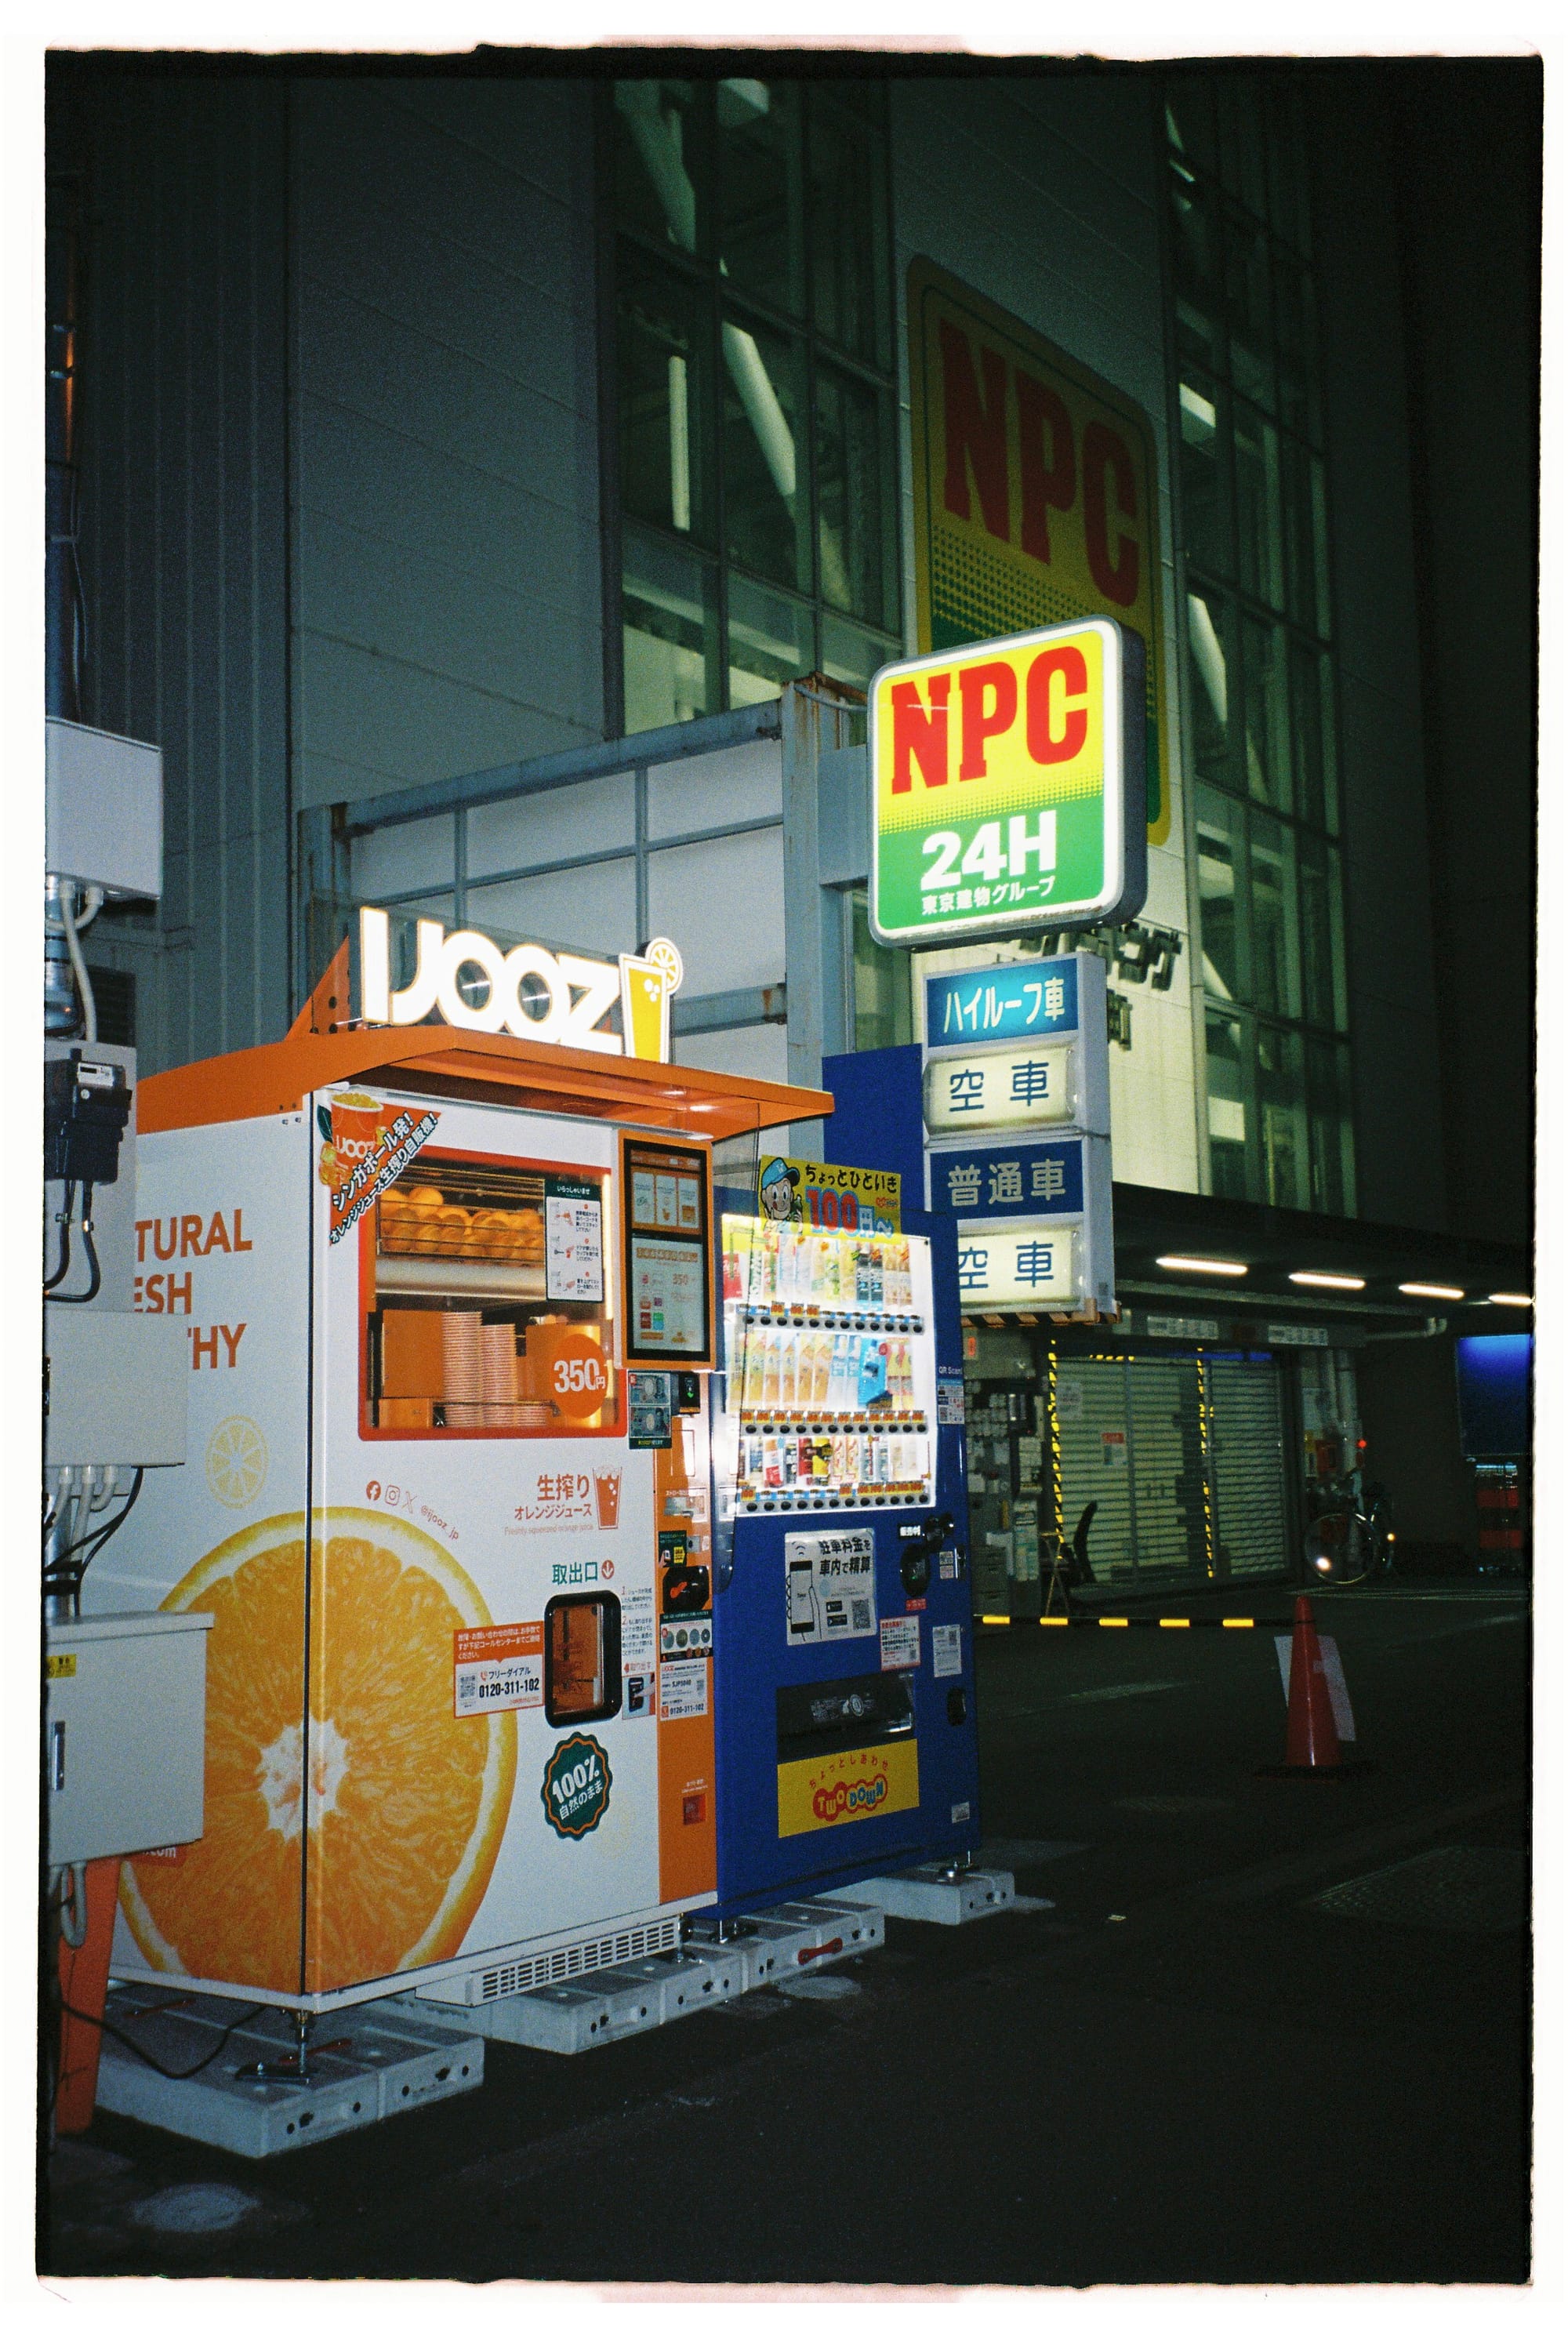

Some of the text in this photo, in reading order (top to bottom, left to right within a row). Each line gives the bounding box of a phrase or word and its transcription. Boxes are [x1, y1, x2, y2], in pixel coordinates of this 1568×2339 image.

[941, 314, 1140, 608] NPC
[891, 645, 1087, 795] NPC
[920, 809, 1057, 892] 24H
[921, 876, 1056, 915] 東京建物グループ
[944, 976, 1065, 1034] ハイルーフ車
[949, 1059, 1050, 1113] 空車
[557, 1185, 590, 1195] いらっしゃいませ
[805, 1164, 898, 1193] ちょっとひといき
[947, 1157, 1067, 1208] 普通車
[187, 1323, 247, 1371] HY
[554, 1358, 607, 1393] 350円
[536, 1474, 590, 1502] 生搾り
[514, 1503, 593, 1521] オレンジジュース
[818, 1537, 871, 1556] 駐車料金を
[552, 1561, 598, 1585] 取出口
[819, 1556, 871, 1576] 車内で精算
[479, 1678, 539, 1698] 0120-311-102
[488, 1666, 532, 1680] フリーダイアル
[552, 1754, 600, 1804] 100%
[809, 1754, 889, 1789] ちょっとしあわせ
[558, 1779, 604, 1820] 自然のまま
[818, 1779, 884, 1814] TWO DOWN
